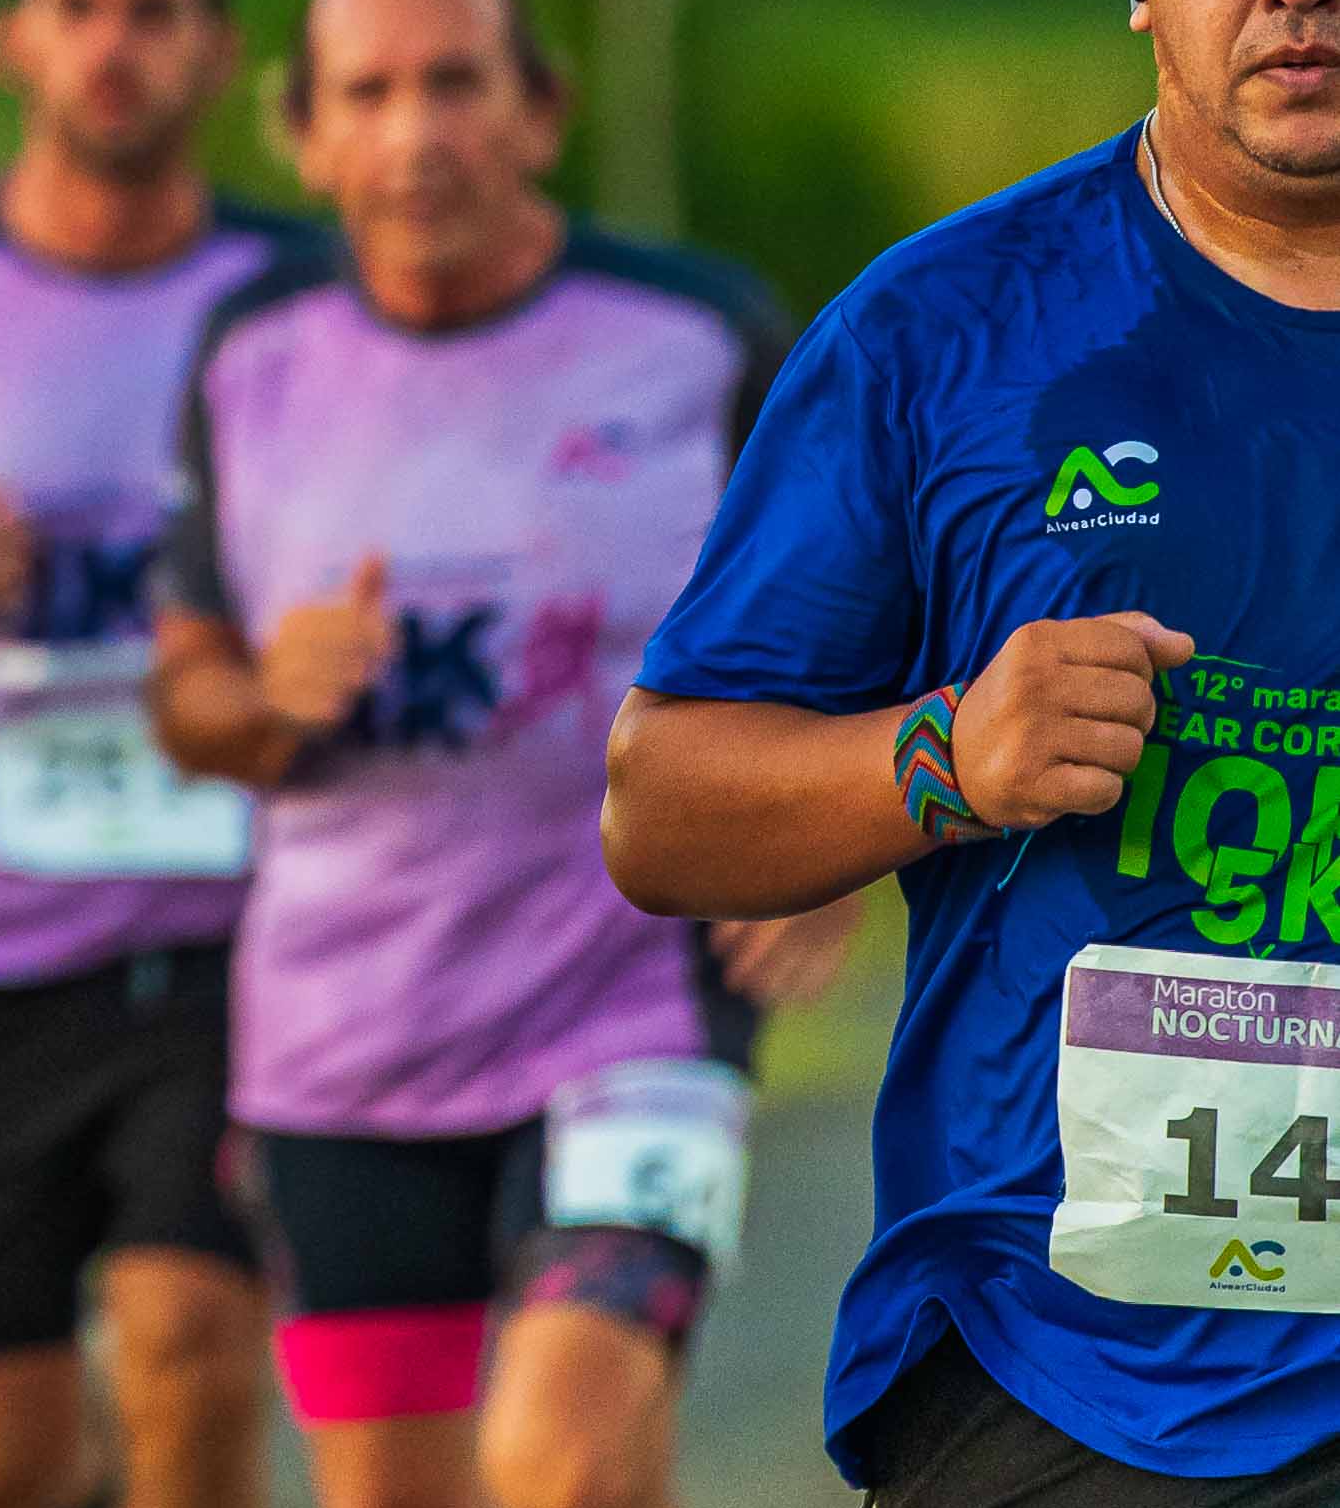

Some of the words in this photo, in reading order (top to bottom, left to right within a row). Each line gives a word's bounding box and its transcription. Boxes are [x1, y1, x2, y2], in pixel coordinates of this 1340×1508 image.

[1046, 511, 1160, 534] AlvearCiudad
[1190, 842, 1340, 946] 5K
[1152, 976, 1277, 1012] Maratón
[1163, 1105, 1340, 1223] 14
